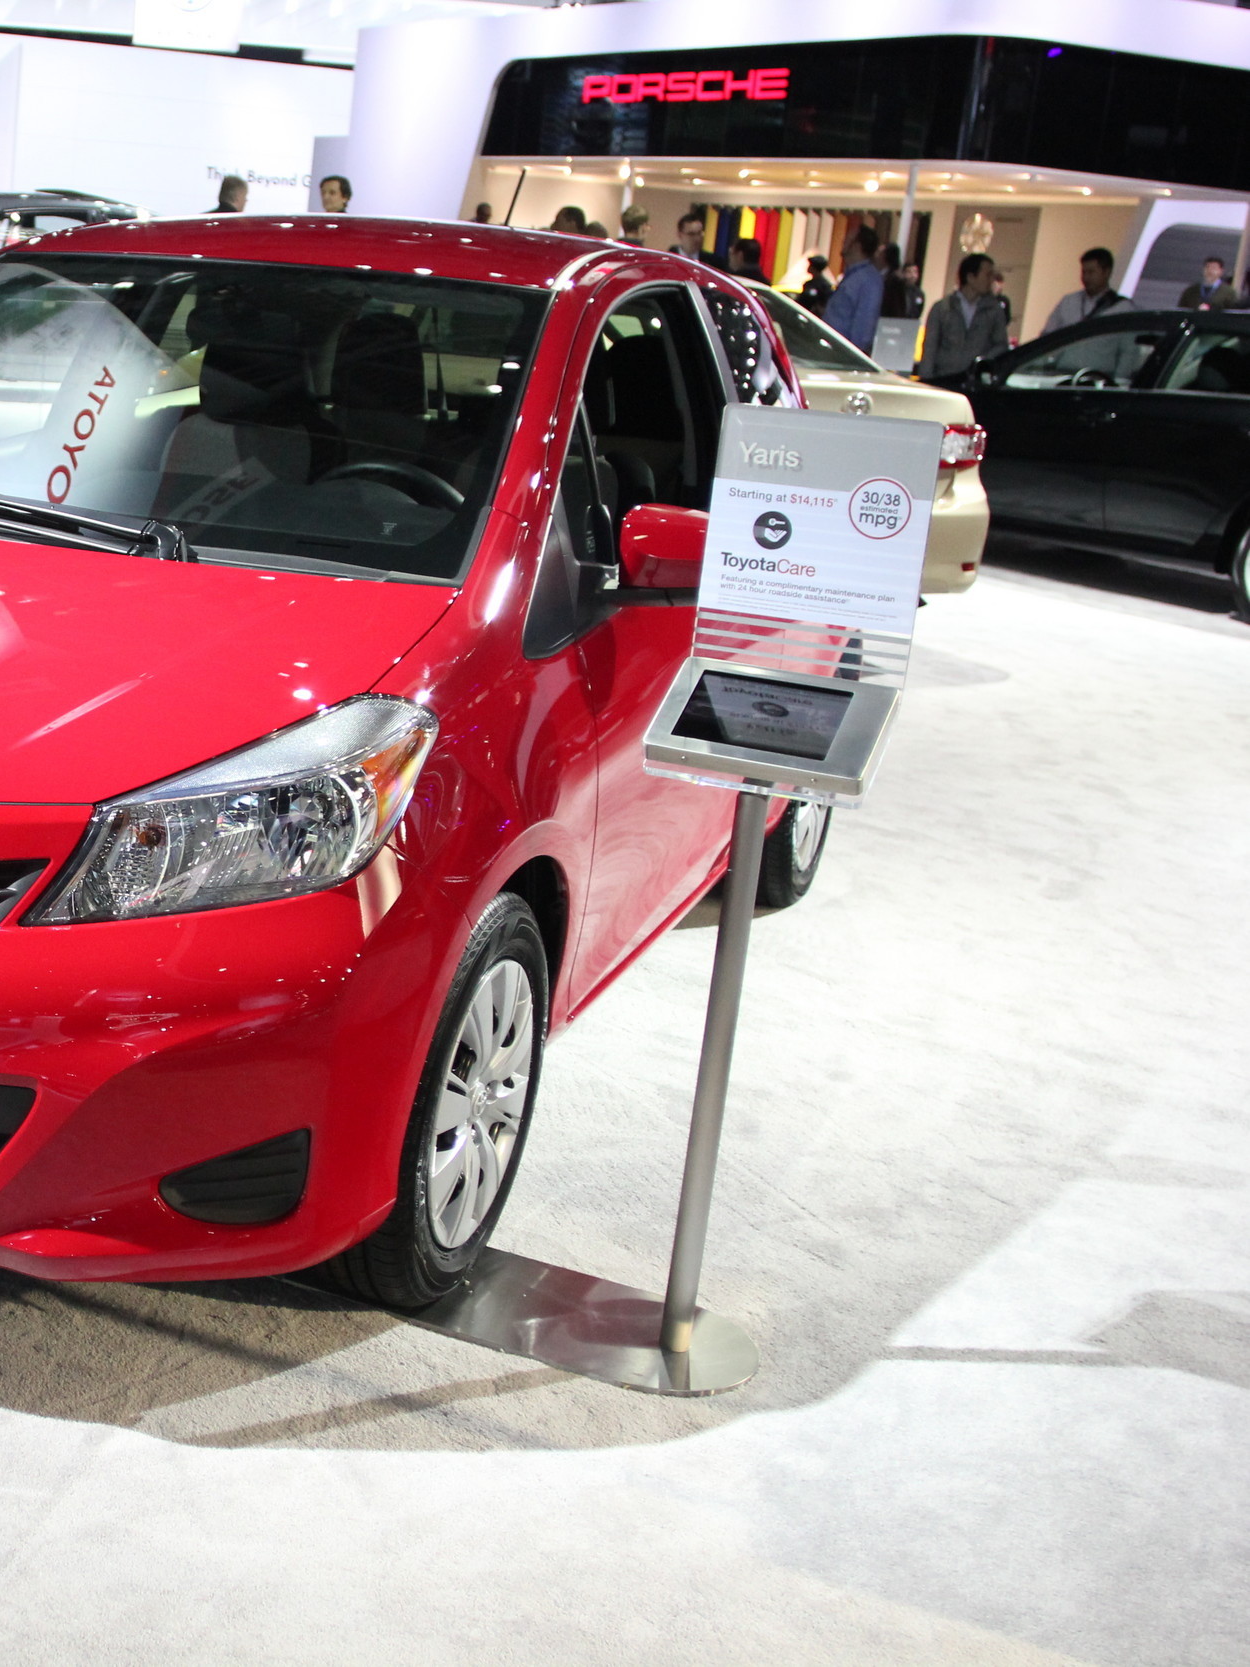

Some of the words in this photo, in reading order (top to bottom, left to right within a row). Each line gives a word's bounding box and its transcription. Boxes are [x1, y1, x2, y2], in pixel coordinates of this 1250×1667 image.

[582, 67, 790, 104] PORSCHE
[247, 169, 297, 187] Beyond
[739, 441, 801, 468] Yaris
[729, 487, 772, 503] Starting
[777, 494, 787, 503] at
[790, 493, 834, 508] $14,115
[861, 491, 901, 507] 30/38
[860, 505, 899, 515] estimated
[859, 512, 898, 529] mpg
[721, 551, 816, 577] ToyotaCare
[721, 574, 757, 586] Featuring
[766, 579, 823, 595] complimentary
[824, 588, 876, 601] maintenance
[877, 594, 895, 604] plan
[749, 585, 766, 594] hour
[768, 588, 802, 599] roadside
[804, 593, 847, 604] assistance
